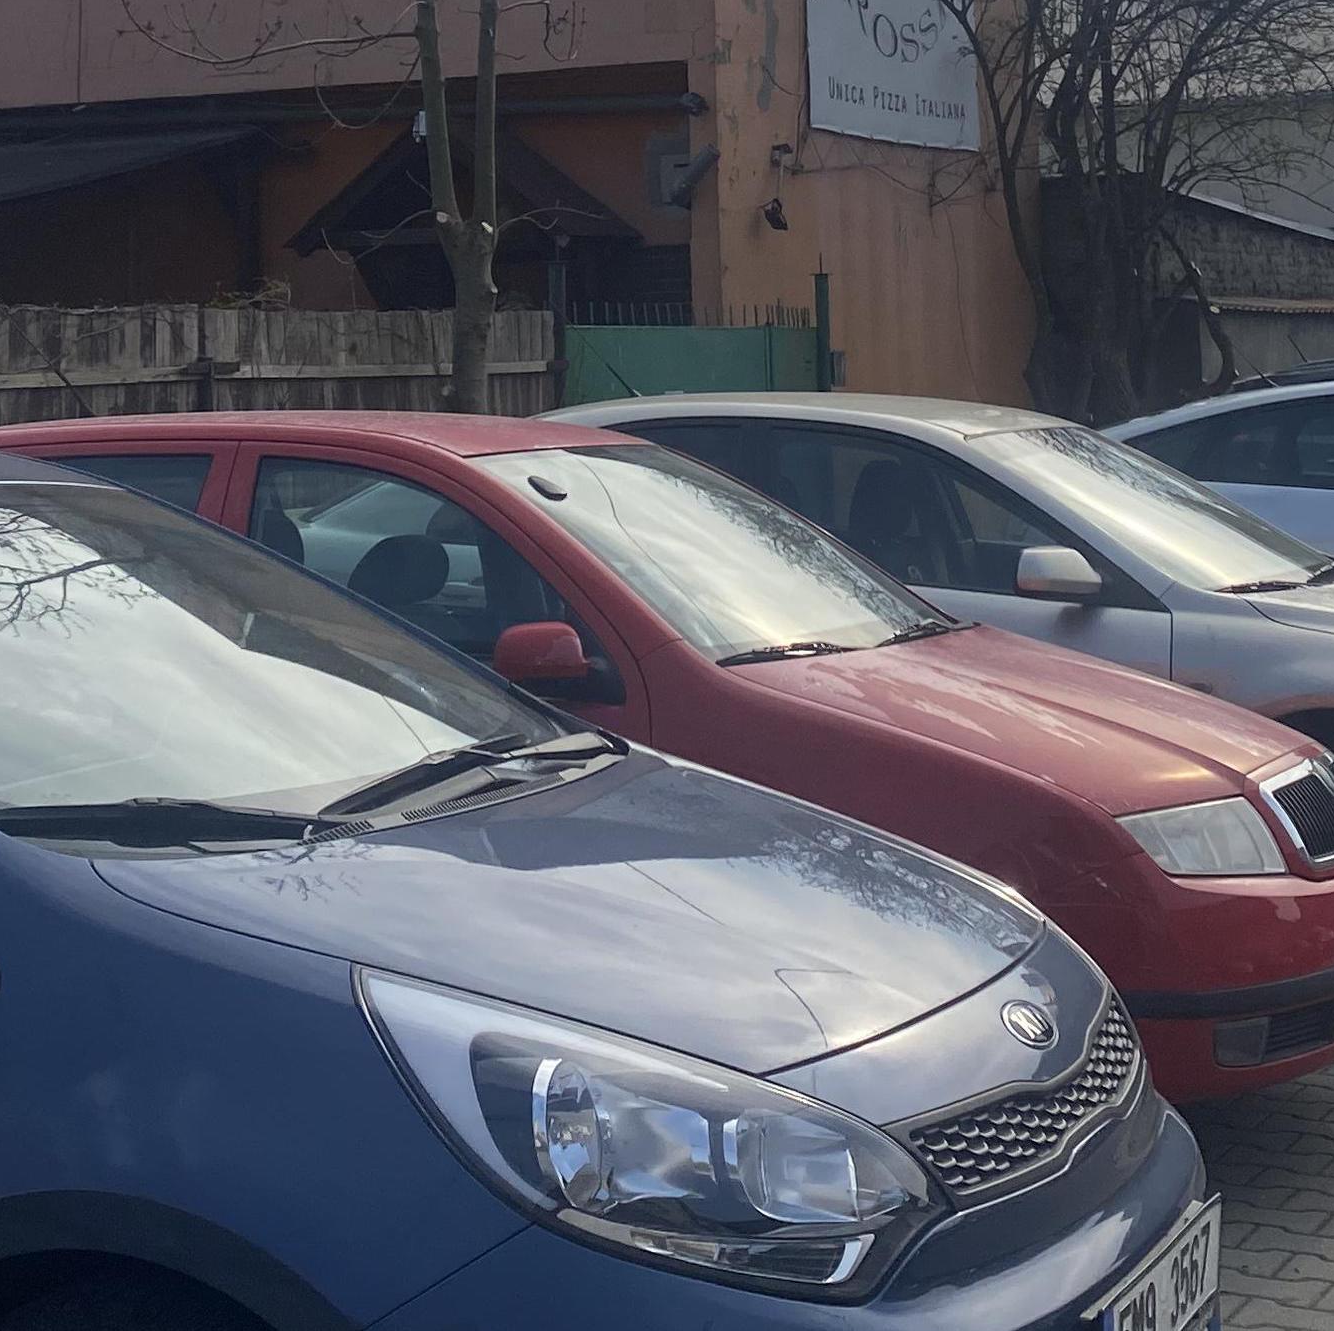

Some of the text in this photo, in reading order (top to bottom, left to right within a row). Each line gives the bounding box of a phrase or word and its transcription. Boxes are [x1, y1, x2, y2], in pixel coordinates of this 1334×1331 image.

[873, 86, 908, 113] PIZZA
[916, 93, 966, 118] ITALIANA
[1170, 1221, 1211, 1328] 3567
